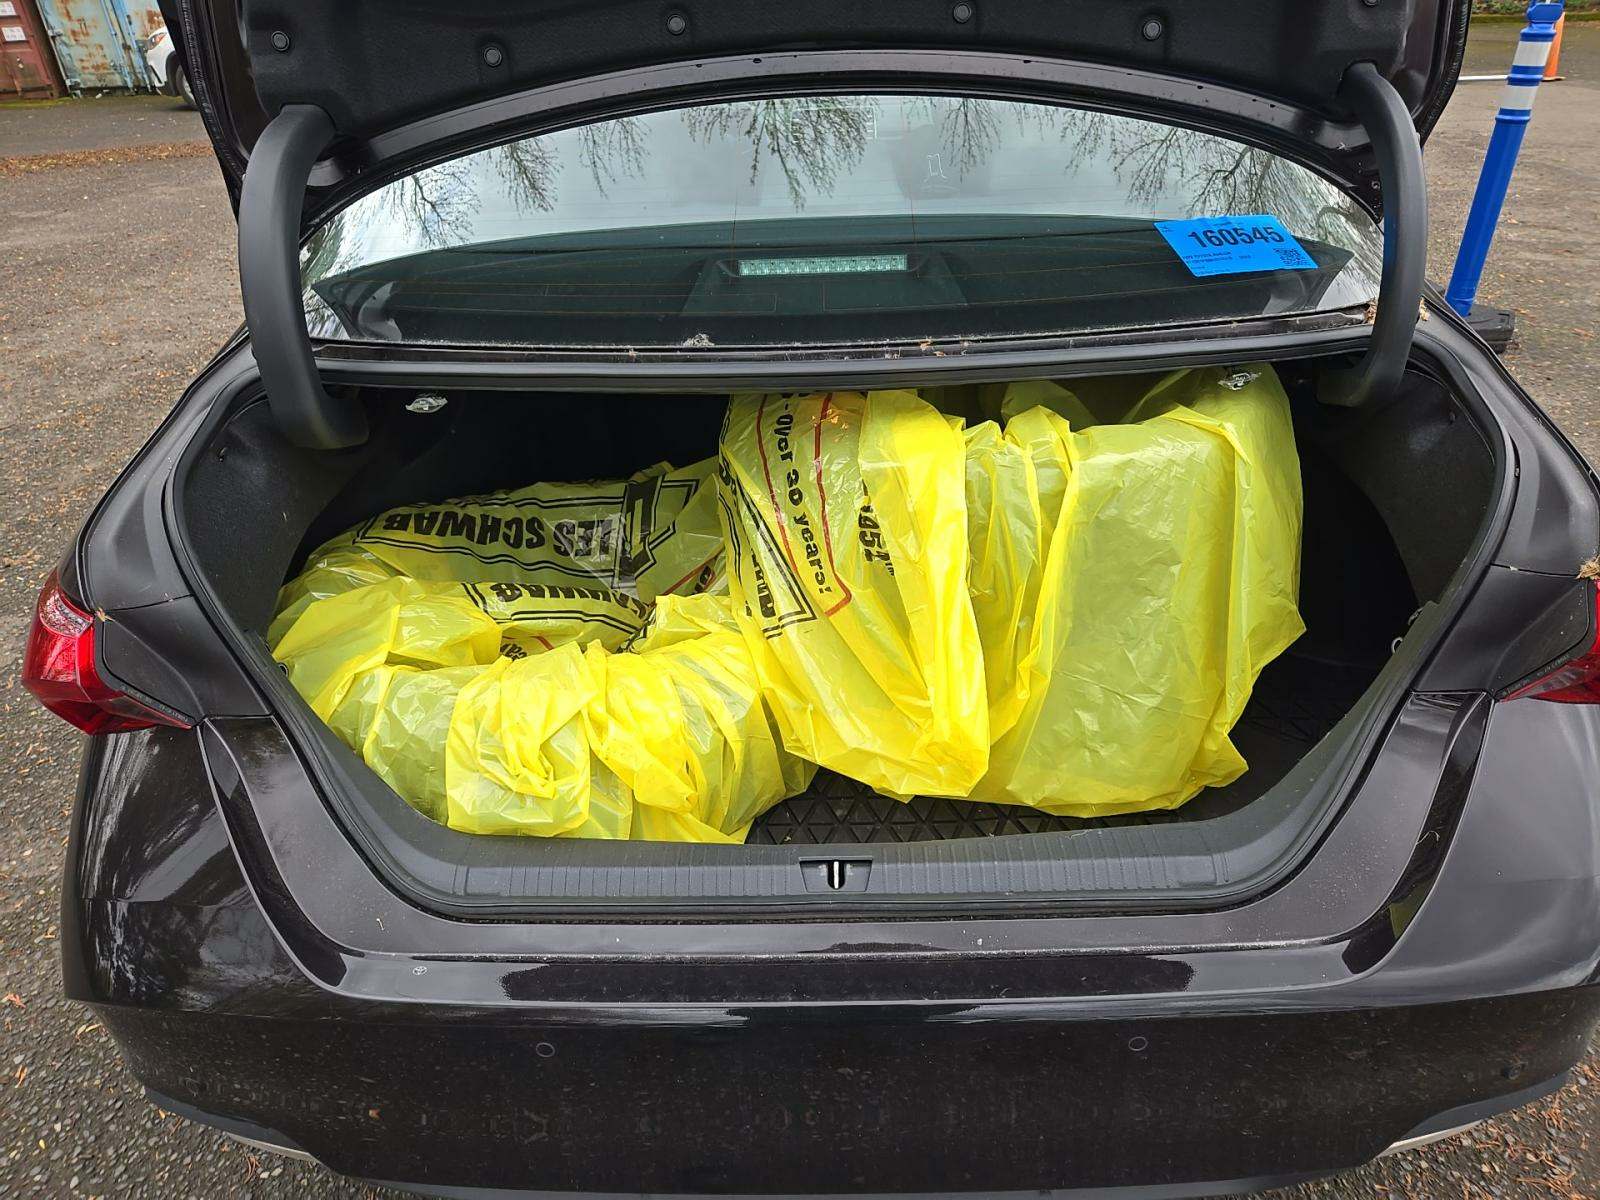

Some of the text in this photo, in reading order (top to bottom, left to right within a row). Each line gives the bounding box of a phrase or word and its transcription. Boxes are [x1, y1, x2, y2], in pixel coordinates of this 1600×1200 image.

[1187, 226, 1285, 248] 160545
[773, 413, 794, 463] Over
[785, 468, 803, 507] 30
[383, 510, 615, 557] LES SCHWAB
[793, 512, 834, 594] years!
